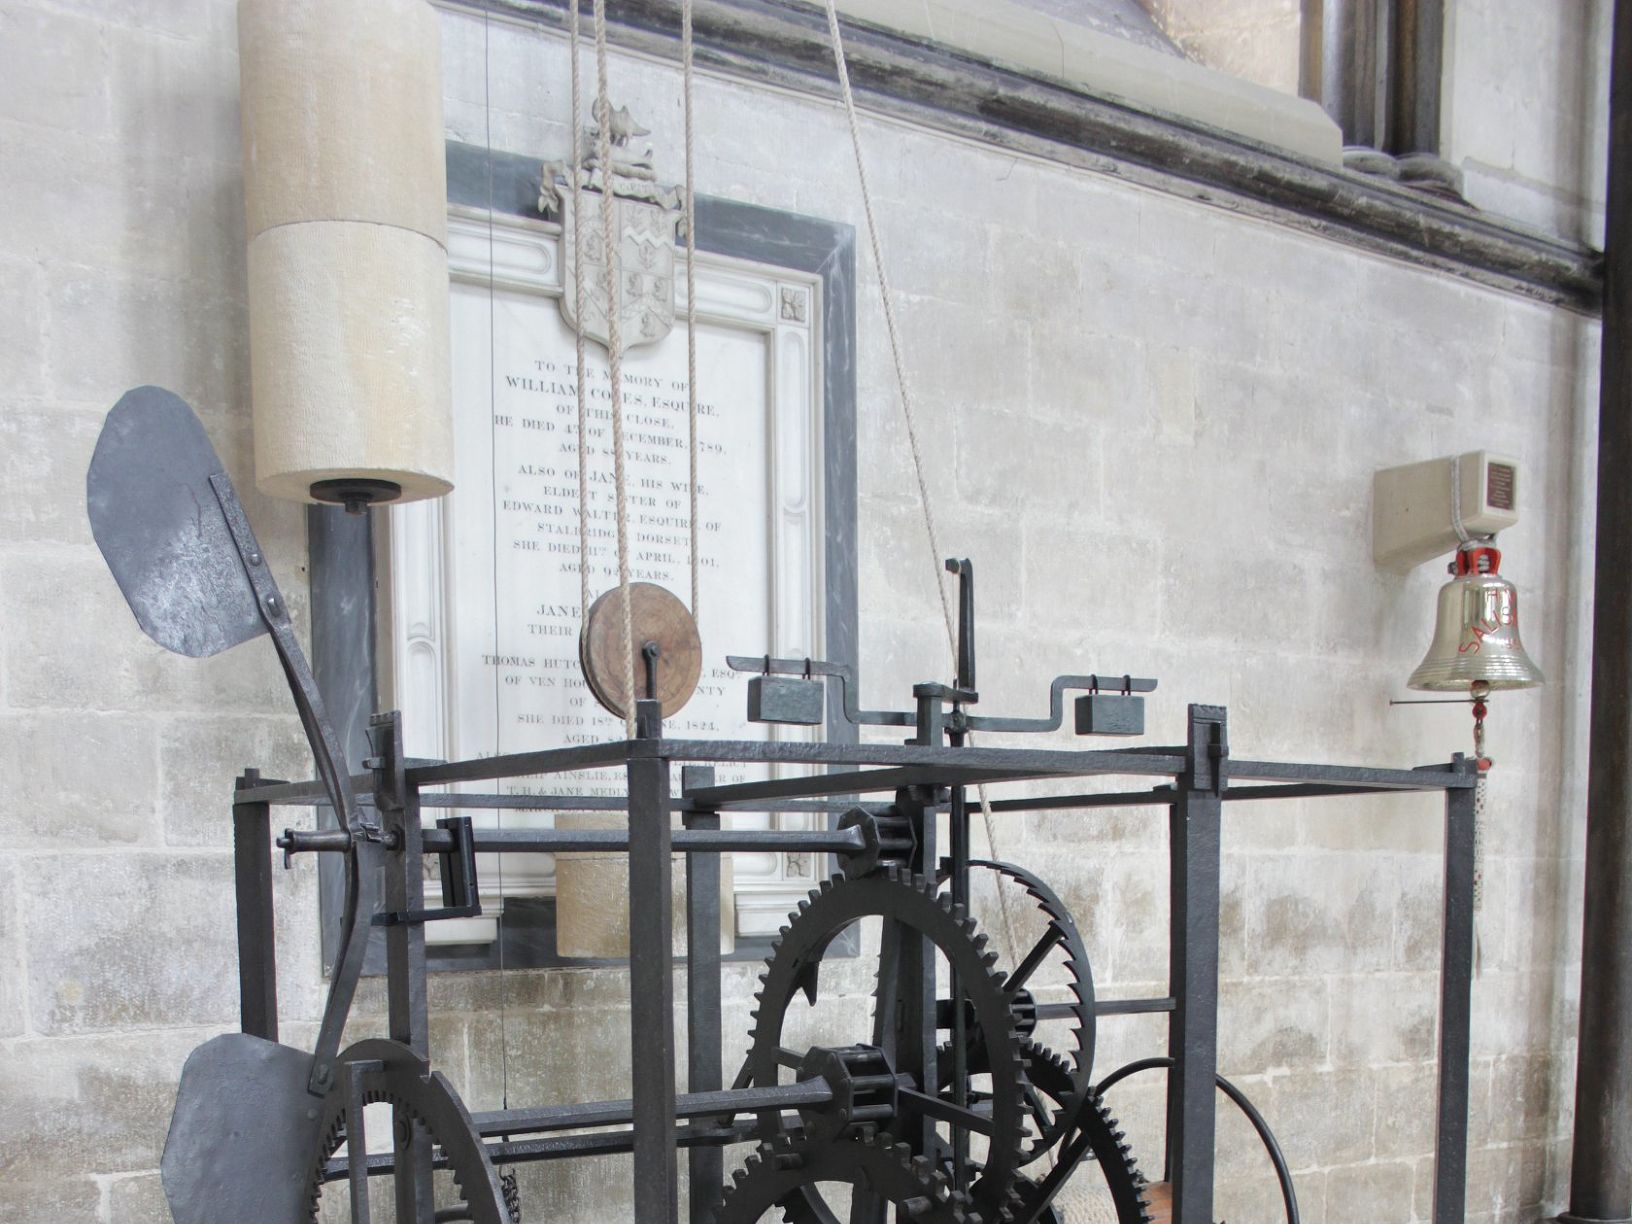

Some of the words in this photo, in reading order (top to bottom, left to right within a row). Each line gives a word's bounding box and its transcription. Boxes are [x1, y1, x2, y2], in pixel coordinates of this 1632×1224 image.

[534, 360, 556, 373] TO
[562, 364, 594, 379] TE
[602, 370, 663, 389] MMORY
[671, 381, 690, 394] OF
[590, 387, 648, 409] COES,
[556, 404, 576, 415] OF
[495, 414, 513, 428] HE
[521, 418, 556, 432] DIED
[588, 428, 606, 440] OF
[620, 431, 688, 451] ECEMBER,
[560, 443, 596, 456] AGD
[518, 464, 557, 478] ALSO
[640, 477, 664, 490] HIS
[671, 481, 709, 497] WIE,
[543, 486, 598, 501] ELDET
[665, 499, 682, 511] OF
[503, 499, 563, 516] EDWARD
[705, 521, 722, 533] OF
[512, 539, 541, 553] SHE
[547, 542, 581, 555] DIED
[526, 623, 572, 638] THEIR
[481, 654, 536, 668] THOMAS
[505, 675, 521, 686] OF
[528, 678, 556, 689] VEN
[569, 698, 587, 709] OF
[516, 713, 544, 725] SHE
[551, 715, 584, 727] DIED
[562, 734, 600, 746] AGED
[550, 787, 584, 799] JANE
